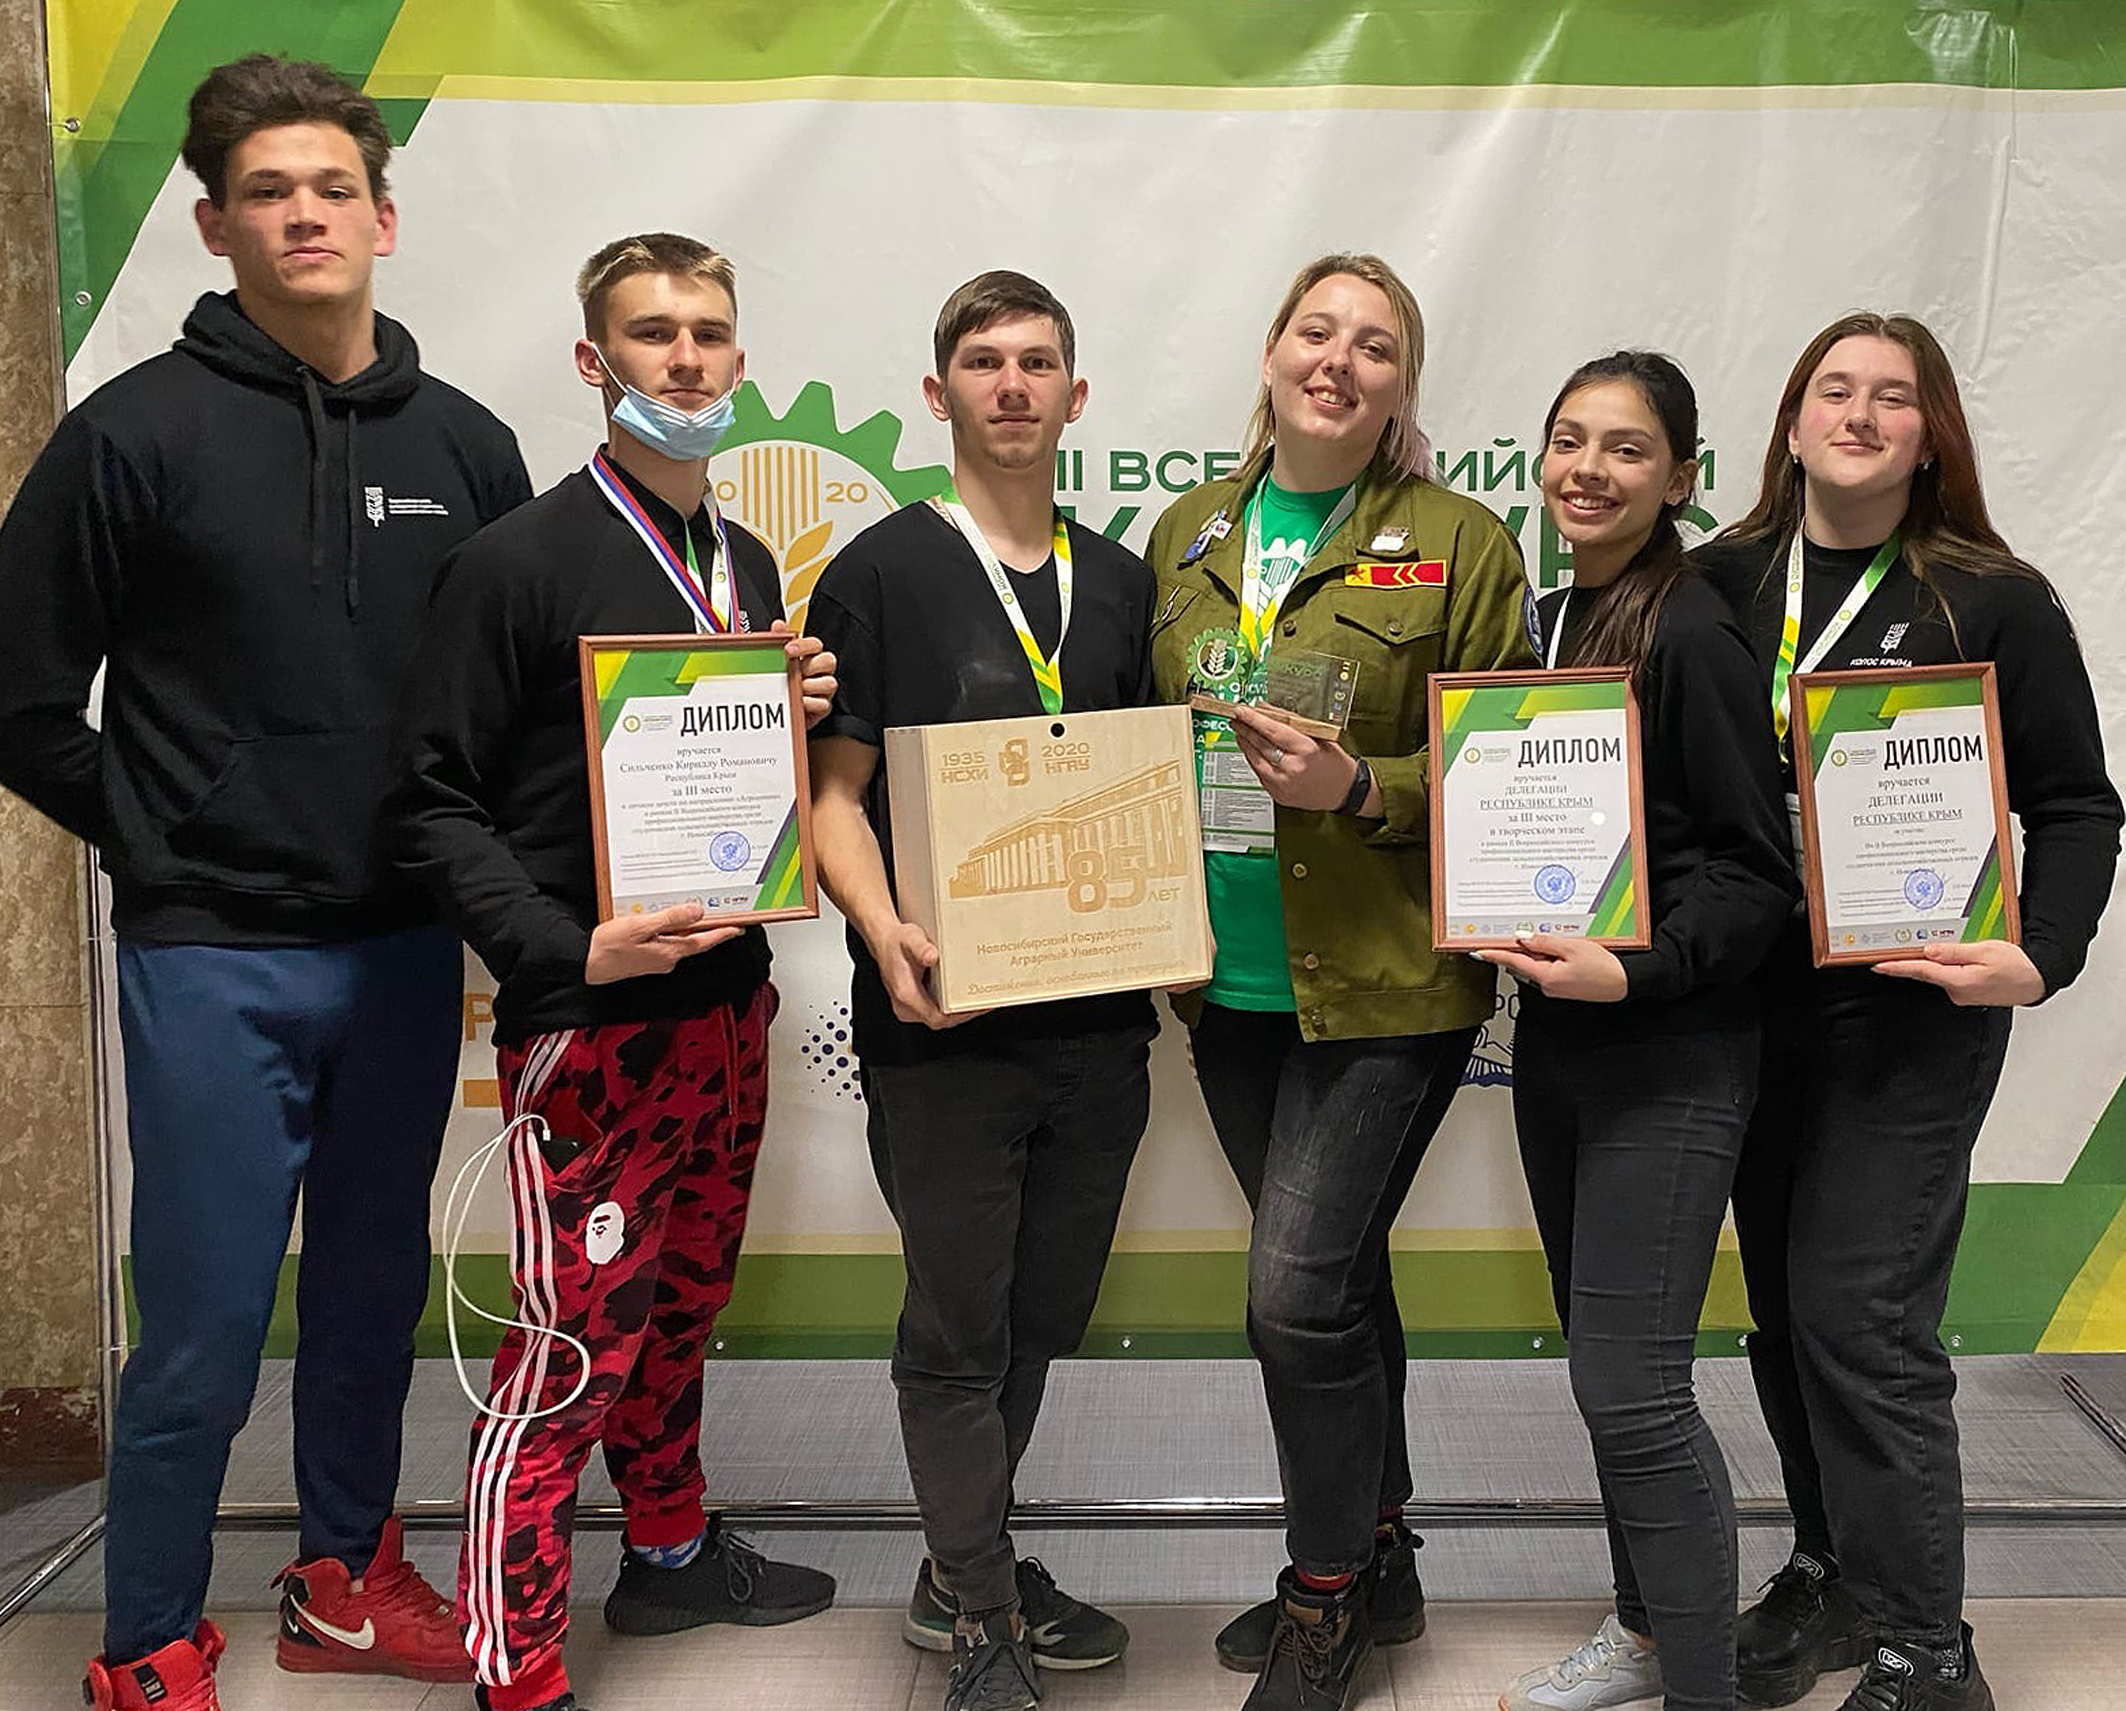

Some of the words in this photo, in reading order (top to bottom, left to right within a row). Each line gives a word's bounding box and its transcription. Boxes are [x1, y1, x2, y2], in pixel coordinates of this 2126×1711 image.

[825, 482, 868, 503] 20
[680, 703, 785, 737] ДИПЛОМ
[677, 746, 721, 757] вручается
[942, 752, 985, 766] 1935
[1042, 742, 1090, 758] 2020
[1518, 737, 1621, 768] ДИПЛОМ
[1883, 735, 1984, 771] ДИПЛОМ
[720, 756, 777, 767] Романовичу
[941, 769, 988, 784] НСХИ
[1046, 759, 1090, 774] НГАУ
[672, 788, 682, 796] за
[685, 786, 698, 796] III
[701, 786, 732, 795] место
[1878, 777, 1931, 790] вручается
[1480, 798, 1556, 810] РЕСПУБЛИКЕ
[1558, 796, 1593, 807] КРЫМ
[1868, 792, 1944, 808] ДЕЛЕГАЦИИ
[1520, 813, 1533, 823] III
[1535, 813, 1567, 822] место
[1853, 811, 1926, 825] РЕСПУБЛИКЕ
[1928, 808, 1963, 820] КРЫМ
[1498, 827, 1556, 837] творческом
[1558, 825, 1585, 835] этапе
[1067, 847, 1146, 913] 85
[977, 935, 1069, 955] Новосибирский
[1010, 949, 1069, 967] Аграрный
[1071, 941, 1143, 960] Университет
